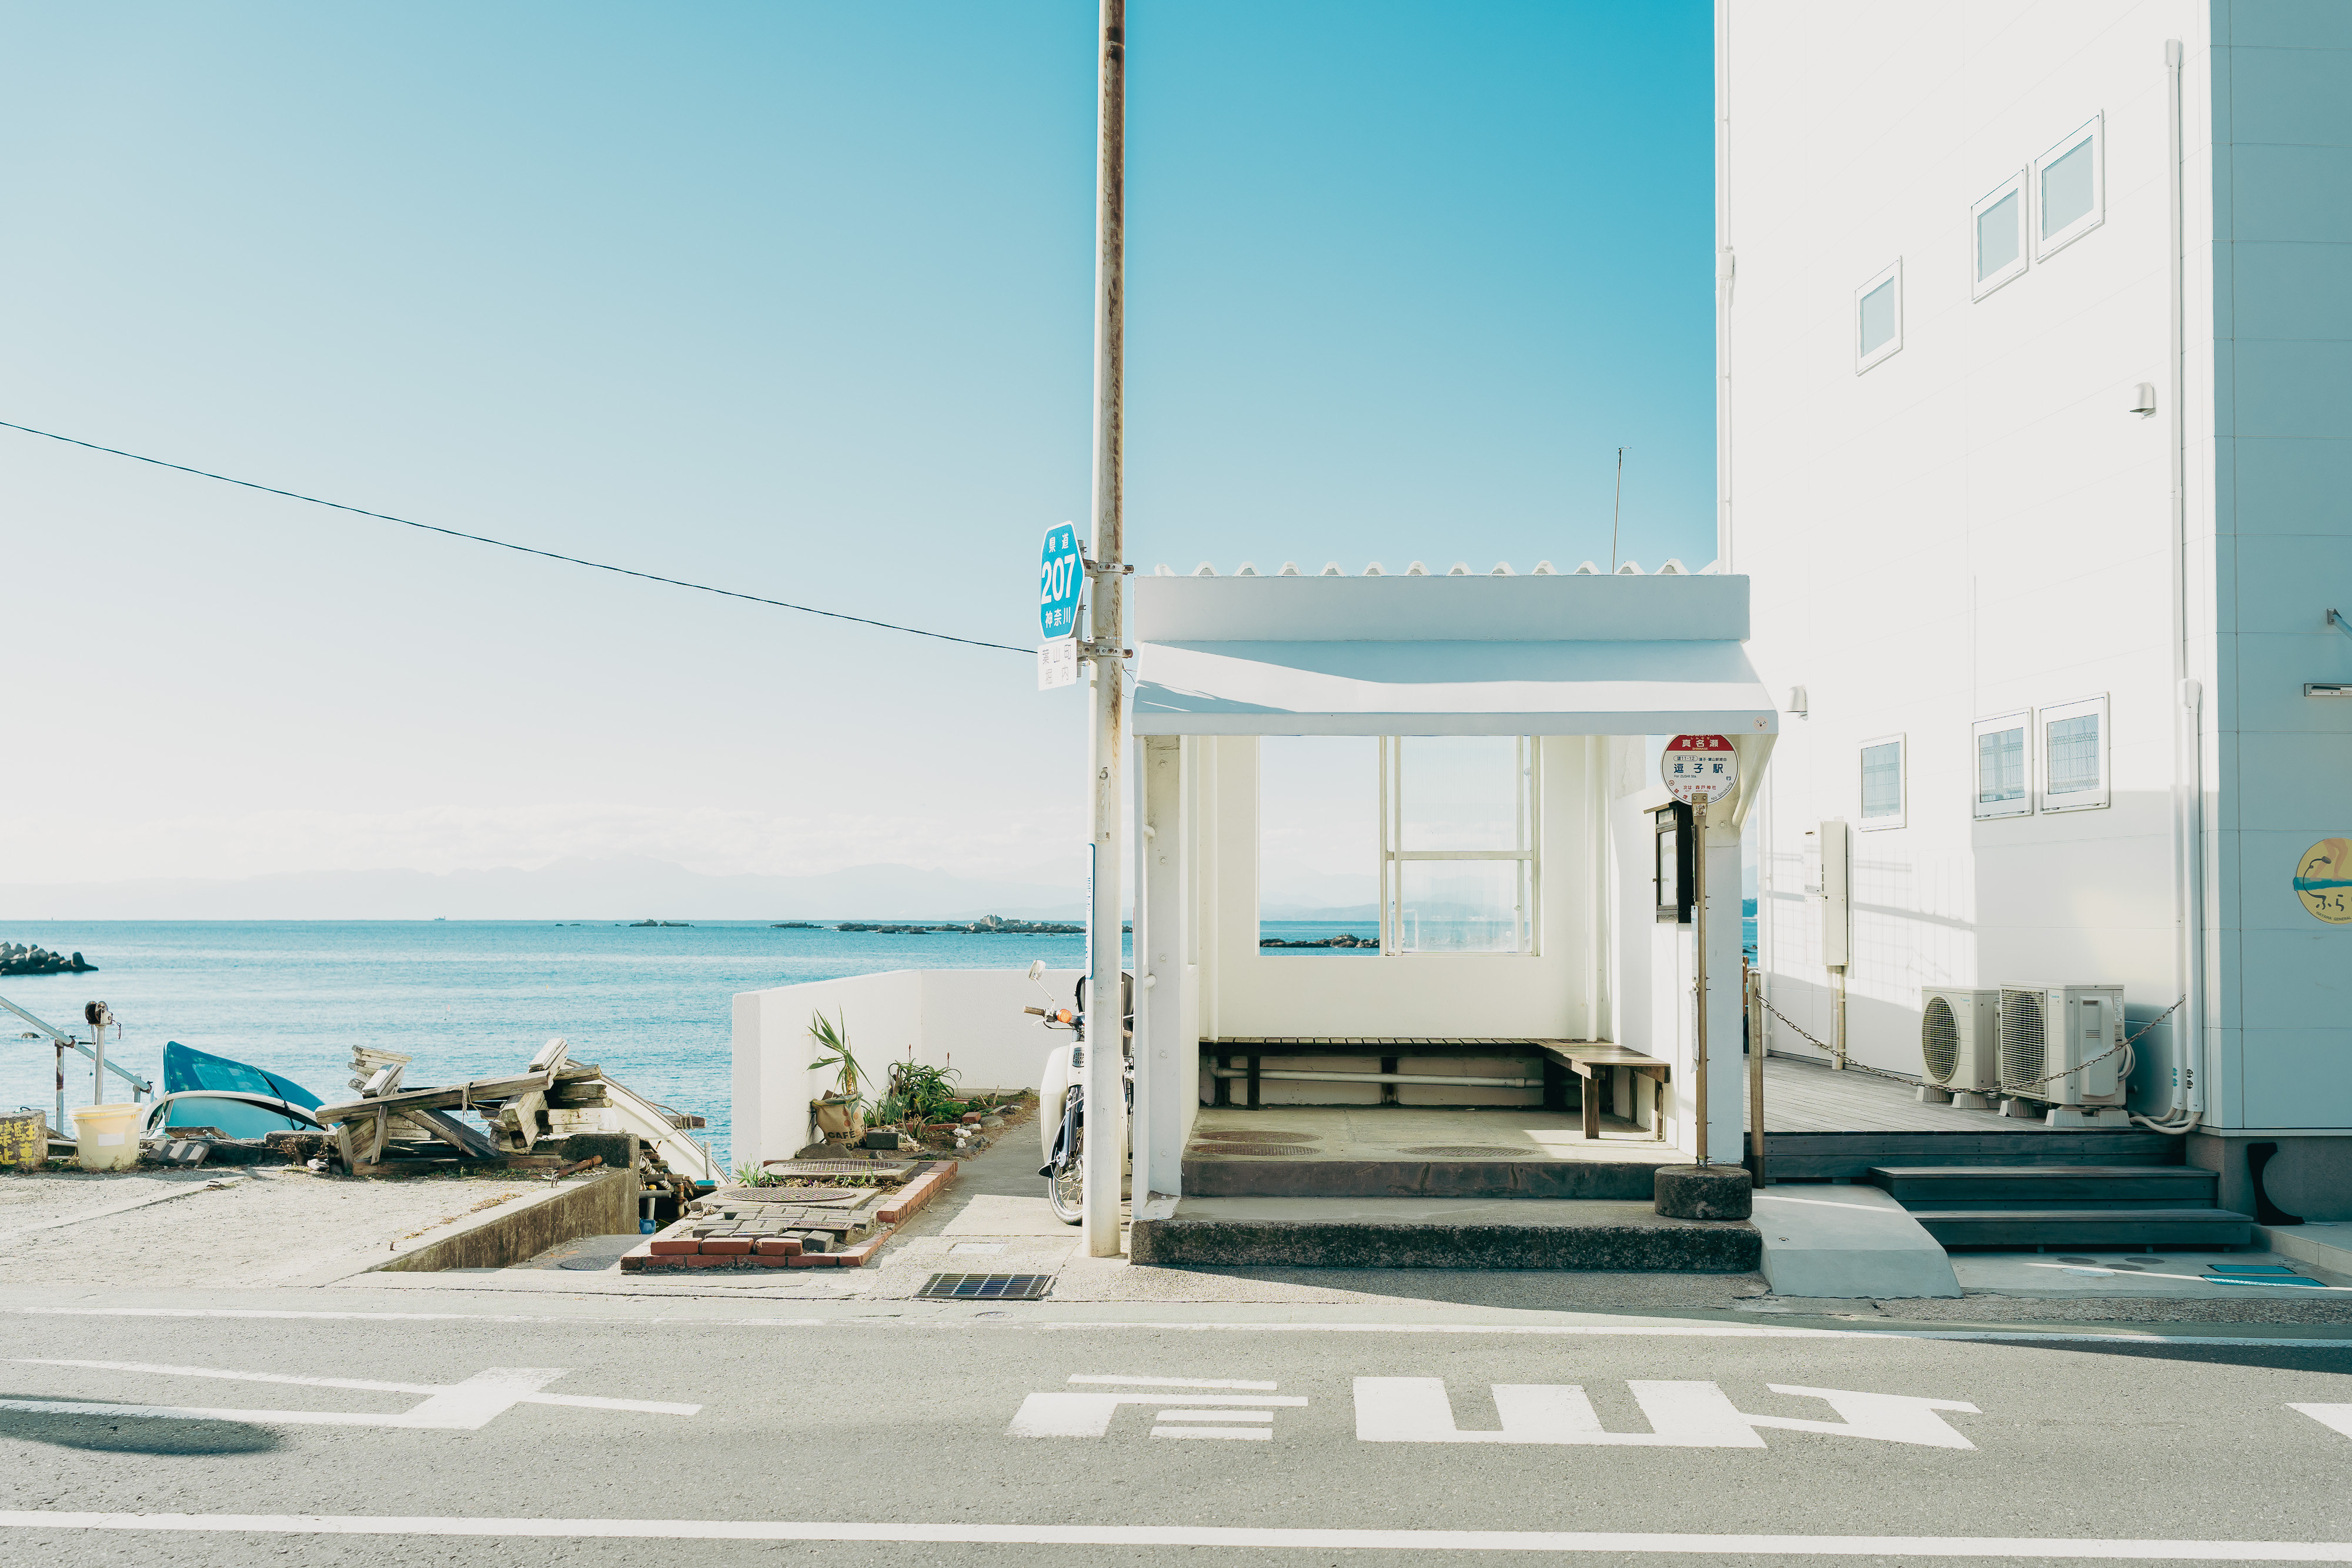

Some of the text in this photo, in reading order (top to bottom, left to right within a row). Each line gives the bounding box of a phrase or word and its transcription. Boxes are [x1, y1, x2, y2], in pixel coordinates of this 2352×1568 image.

[1048, 533, 1069, 553] 県道
[1041, 553, 1075, 605] 207
[1045, 606, 1071, 628] 神奈川
[1043, 644, 1071, 665] 葉山町
[1045, 665, 1069, 685] 堀内
[1682, 739, 1719, 747] 真名瀬
[1673, 763, 1723, 774] 逗子駅
[1717, 782, 1733, 797] Smoking
[2312, 894, 2352, 912] ふら
[2316, 911, 2332, 920] HAYAMA
[12, 1119, 36, 1165] 駐車
[827, 1128, 861, 1139] CAFÉS
